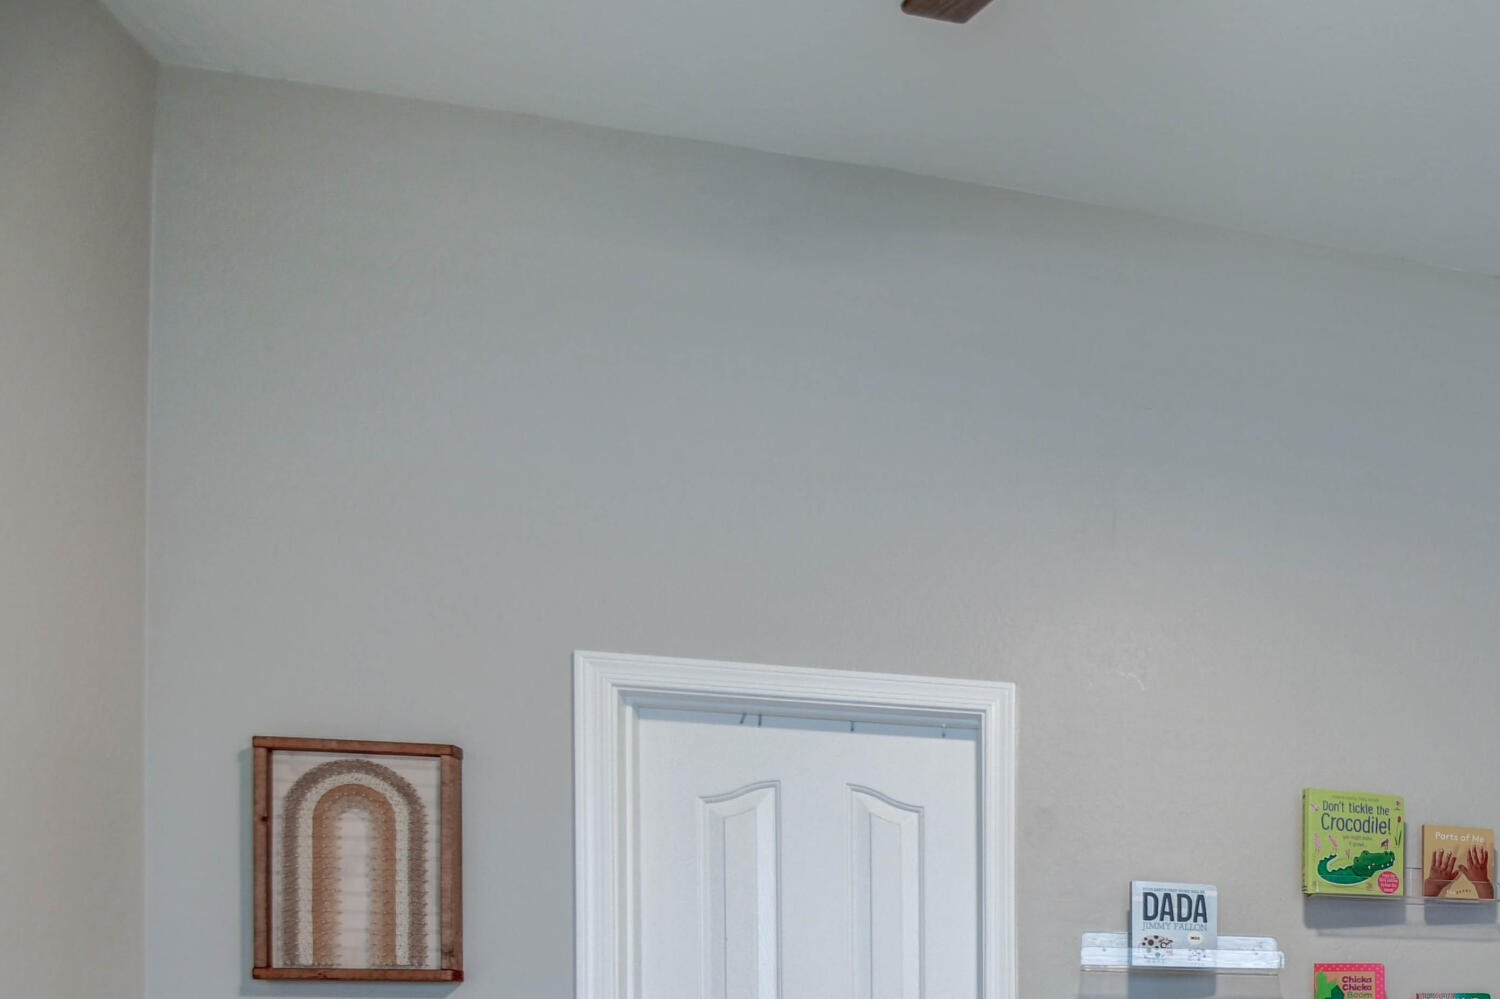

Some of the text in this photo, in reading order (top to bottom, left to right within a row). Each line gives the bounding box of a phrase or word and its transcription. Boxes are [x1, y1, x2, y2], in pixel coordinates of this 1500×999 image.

[1322, 800, 1390, 816] Don't tickle the
[1320, 812, 1391, 835] Crocodile!
[1435, 831, 1486, 843] Parts of Me
[1142, 891, 1208, 923] DADA
[1142, 922, 1208, 932] JIMMY FALLON
[1341, 975, 1373, 984] Chicka
[1341, 983, 1373, 991] Chicka
[1346, 991, 1373, 999] Boom
